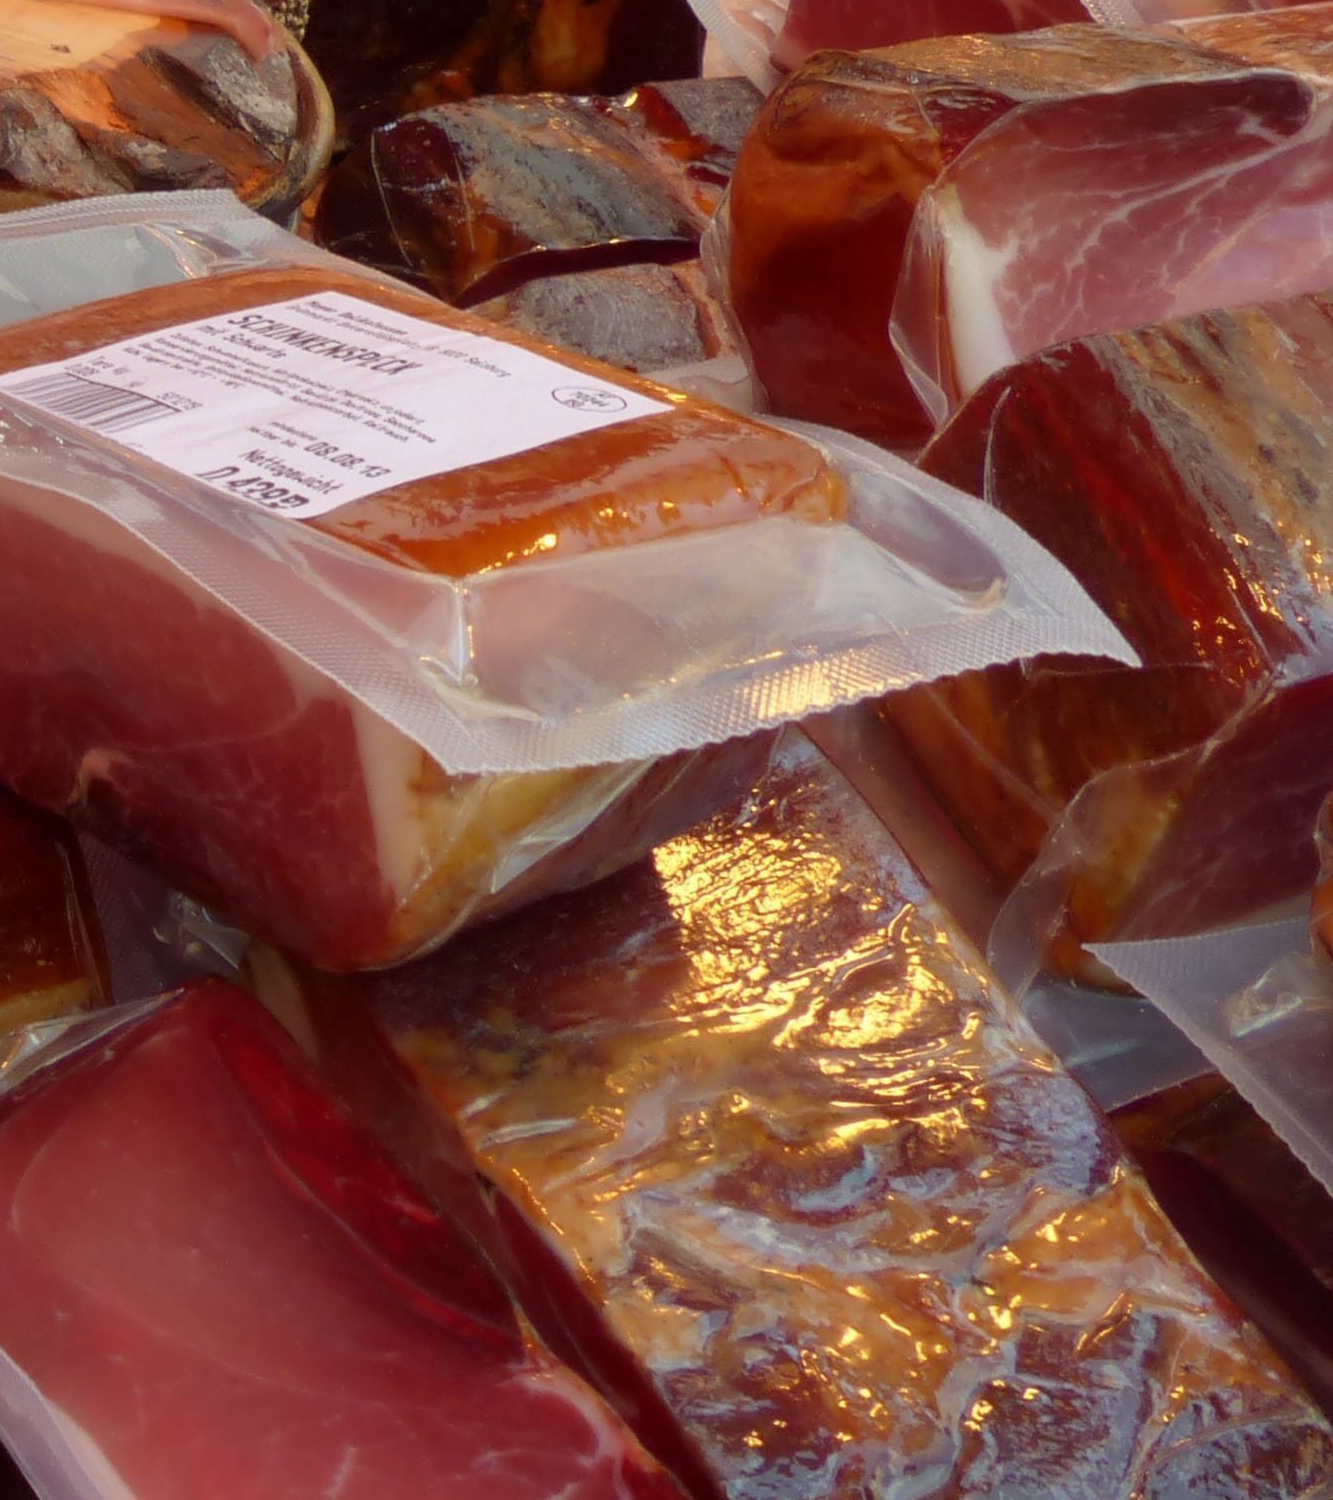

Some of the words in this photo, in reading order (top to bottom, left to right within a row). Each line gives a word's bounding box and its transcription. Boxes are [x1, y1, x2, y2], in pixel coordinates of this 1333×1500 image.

[196, 324, 229, 336] mit
[222, 332, 287, 359] Schwarte
[227, 313, 423, 376] SCHINKENSPECK
[237, 448, 344, 495] Nettogewicht
